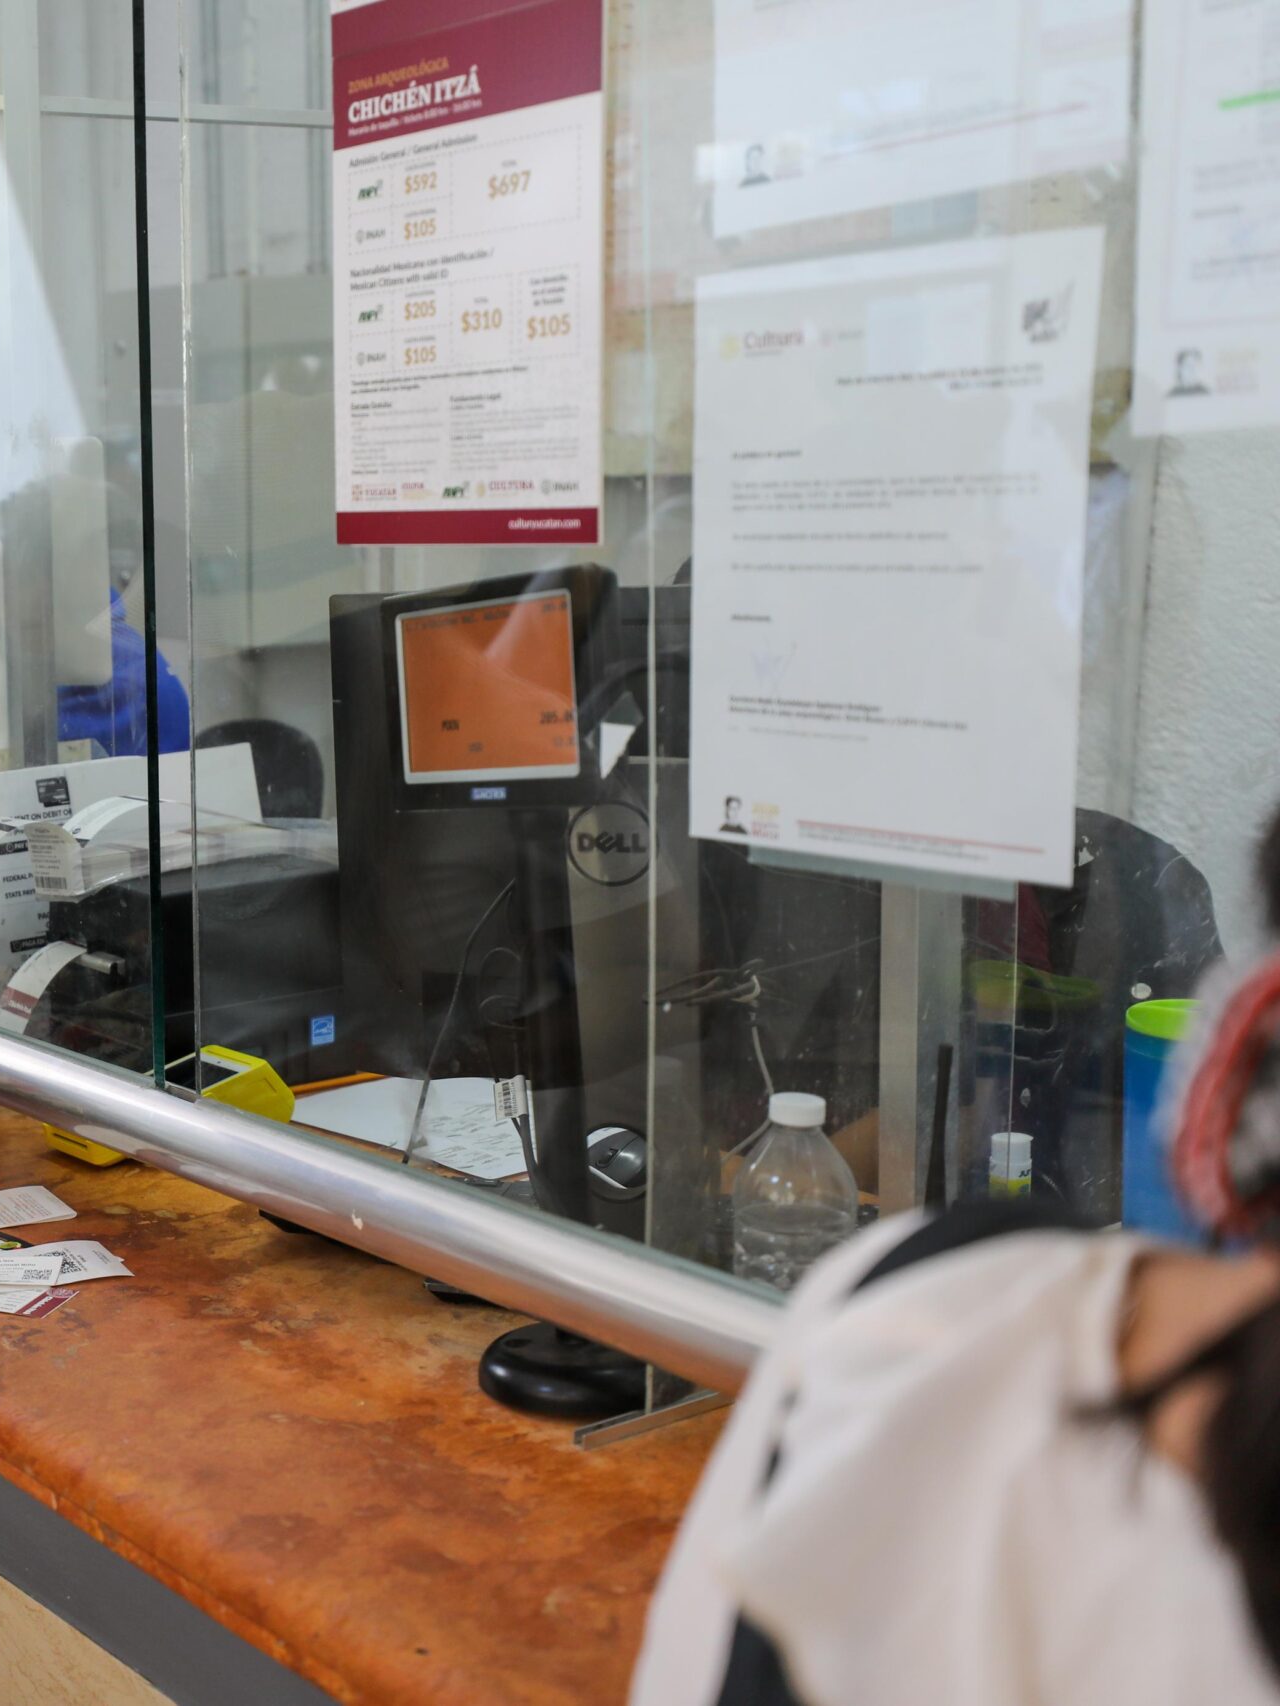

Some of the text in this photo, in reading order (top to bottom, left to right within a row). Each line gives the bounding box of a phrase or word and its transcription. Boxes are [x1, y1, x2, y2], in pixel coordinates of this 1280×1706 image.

[348, 57, 449, 94] ZONA ARQUEOLÓGICA
[348, 80, 432, 123] CHICHÉN
[434, 64, 481, 103] ITZÁ
[380, 149, 405, 161] General
[413, 142, 439, 155] General
[404, 171, 438, 195] $592
[487, 170, 531, 199] $697
[403, 218, 437, 241] $105
[404, 300, 437, 321] $205
[461, 308, 502, 333] $310
[527, 312, 571, 341] $105
[404, 346, 437, 366] $105
[43, 811, 61, 819] DEBIT
[576, 832, 647, 854] DELL
[3, 873, 27, 883] FEDERAL
[5, 890, 21, 899] STATE
